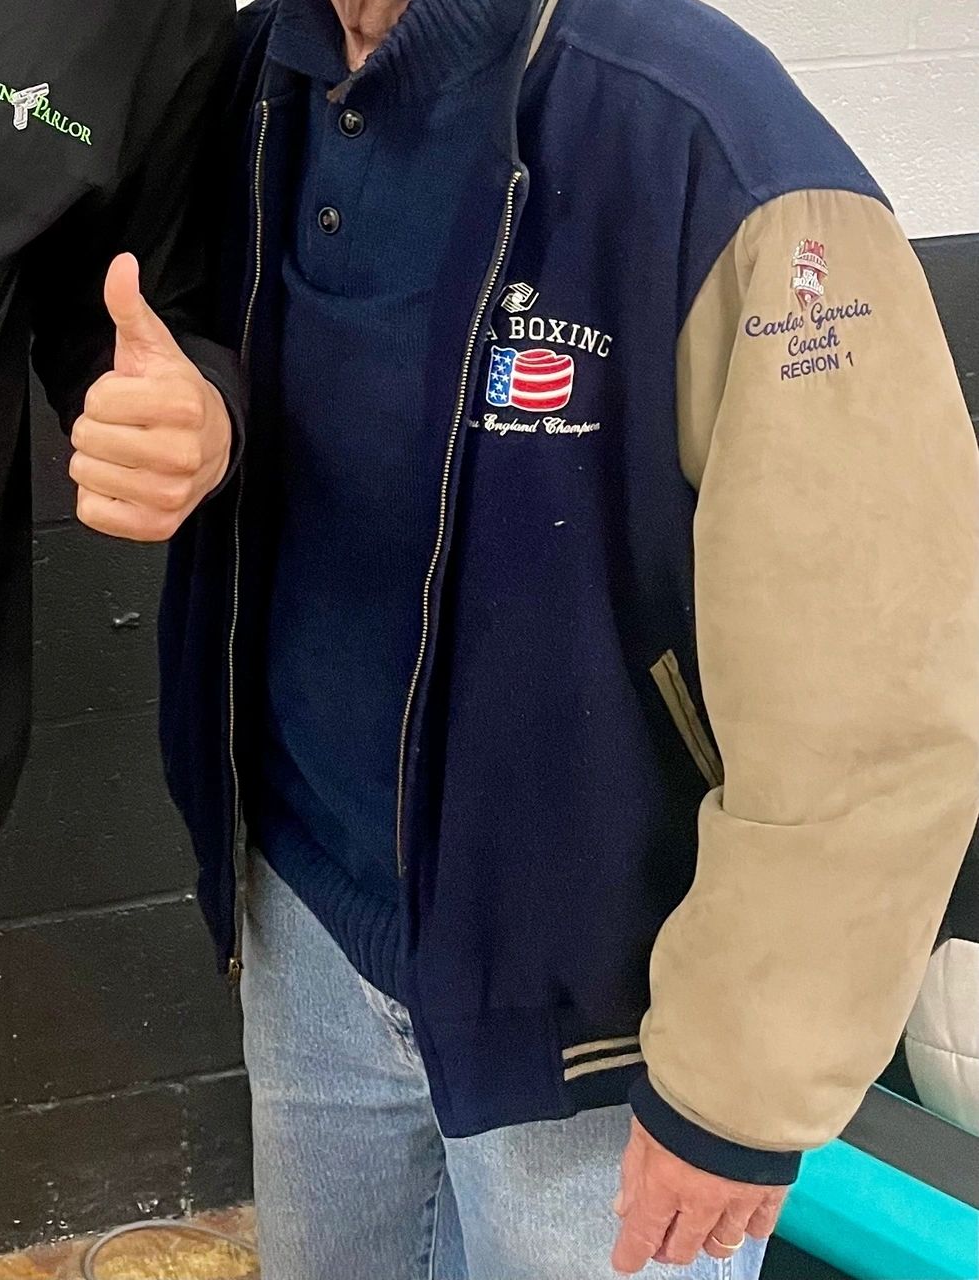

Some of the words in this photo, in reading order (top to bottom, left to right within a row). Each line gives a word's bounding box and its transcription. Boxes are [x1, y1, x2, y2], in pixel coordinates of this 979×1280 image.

[32, 95, 92, 145] PARLOR
[745, 312, 804, 337] Carlos
[810, 299, 872, 330] Garcia
[788, 326, 840, 357] Coach
[780, 353, 840, 380] REGION
[845, 351, 854, 367] 1
[484, 413, 540, 436] England
